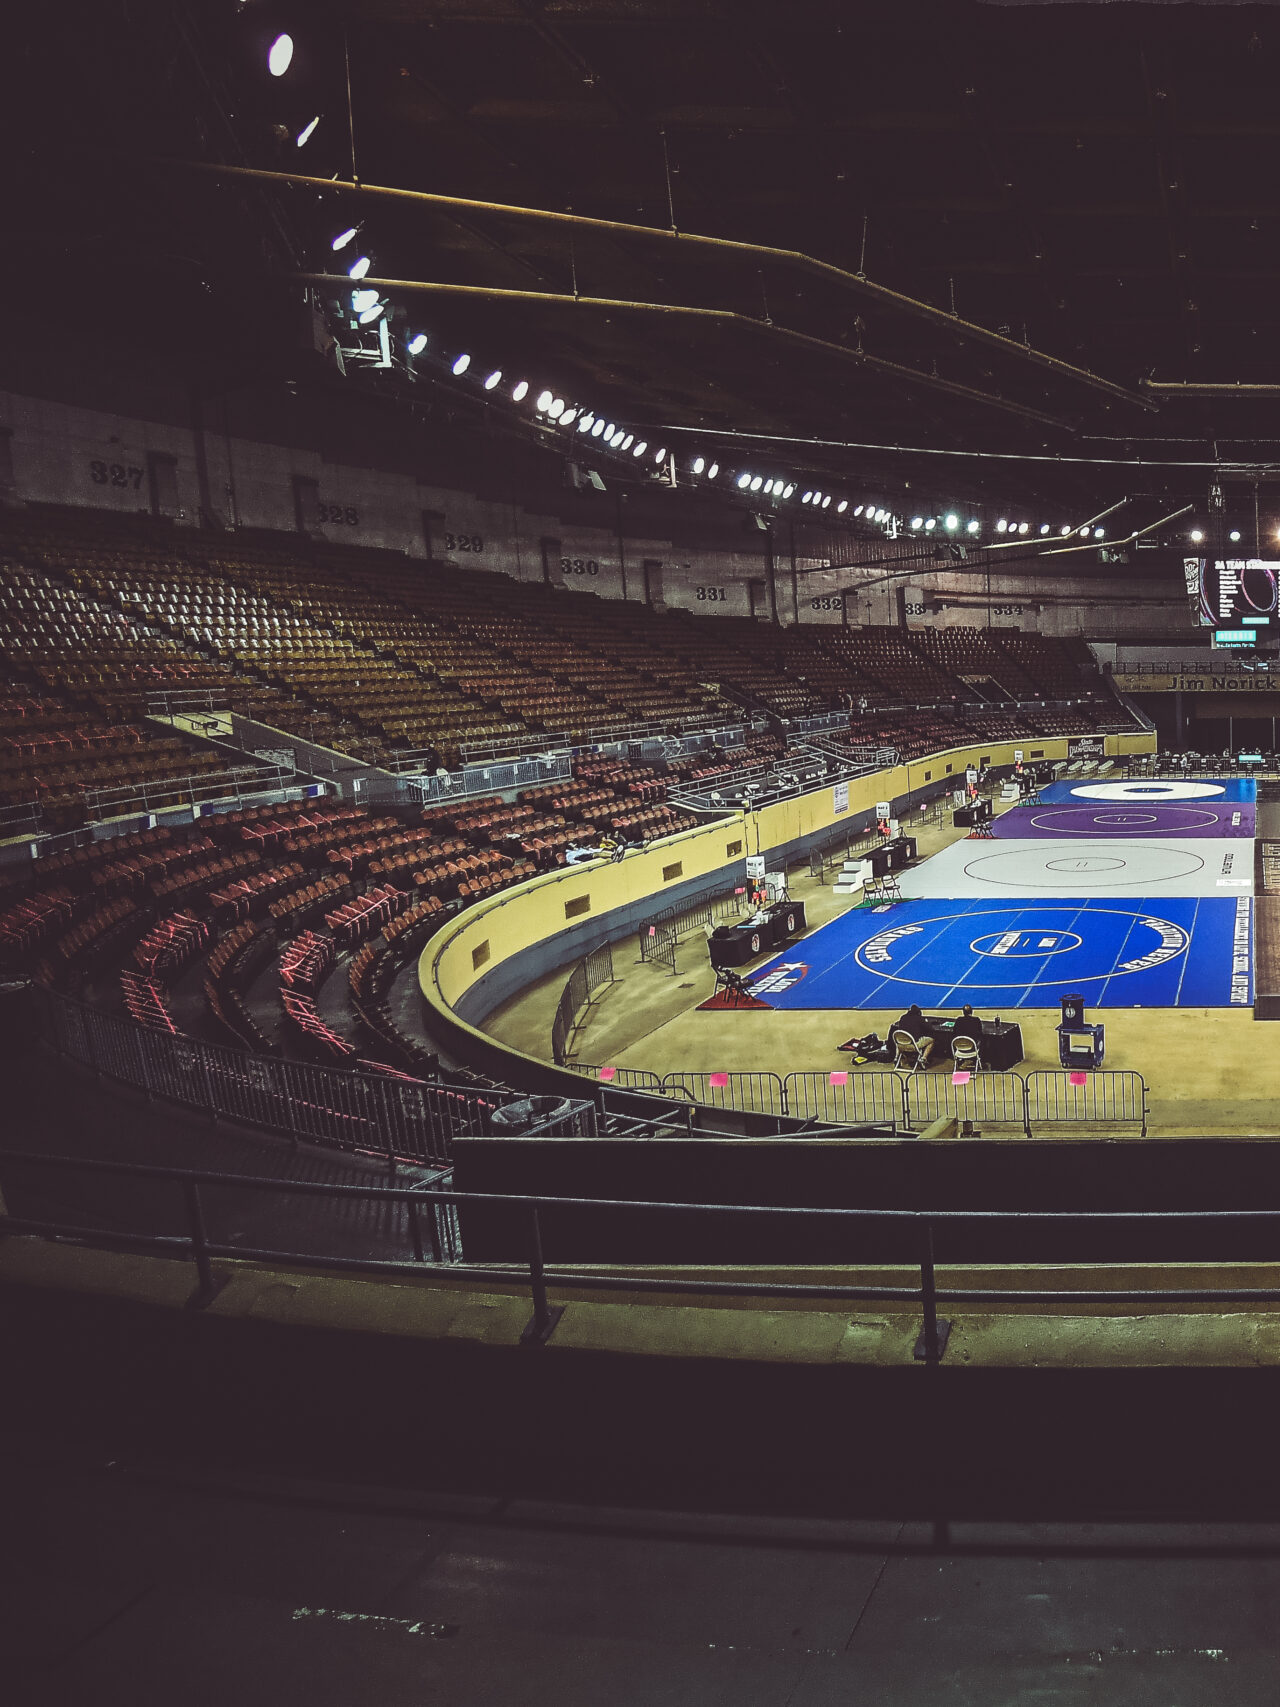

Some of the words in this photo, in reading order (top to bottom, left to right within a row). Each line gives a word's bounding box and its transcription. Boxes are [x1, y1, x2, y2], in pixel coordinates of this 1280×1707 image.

[89, 461, 145, 490] 327
[318, 502, 359, 526] 328
[444, 532, 484, 554] 329
[561, 558, 600, 577] 330
[696, 586, 727, 602] 331
[811, 597, 842, 611] 332
[1167, 675, 1205, 690] Jim
[1212, 675, 1277, 690] Norick
[1118, 948, 1178, 970] NEVER
